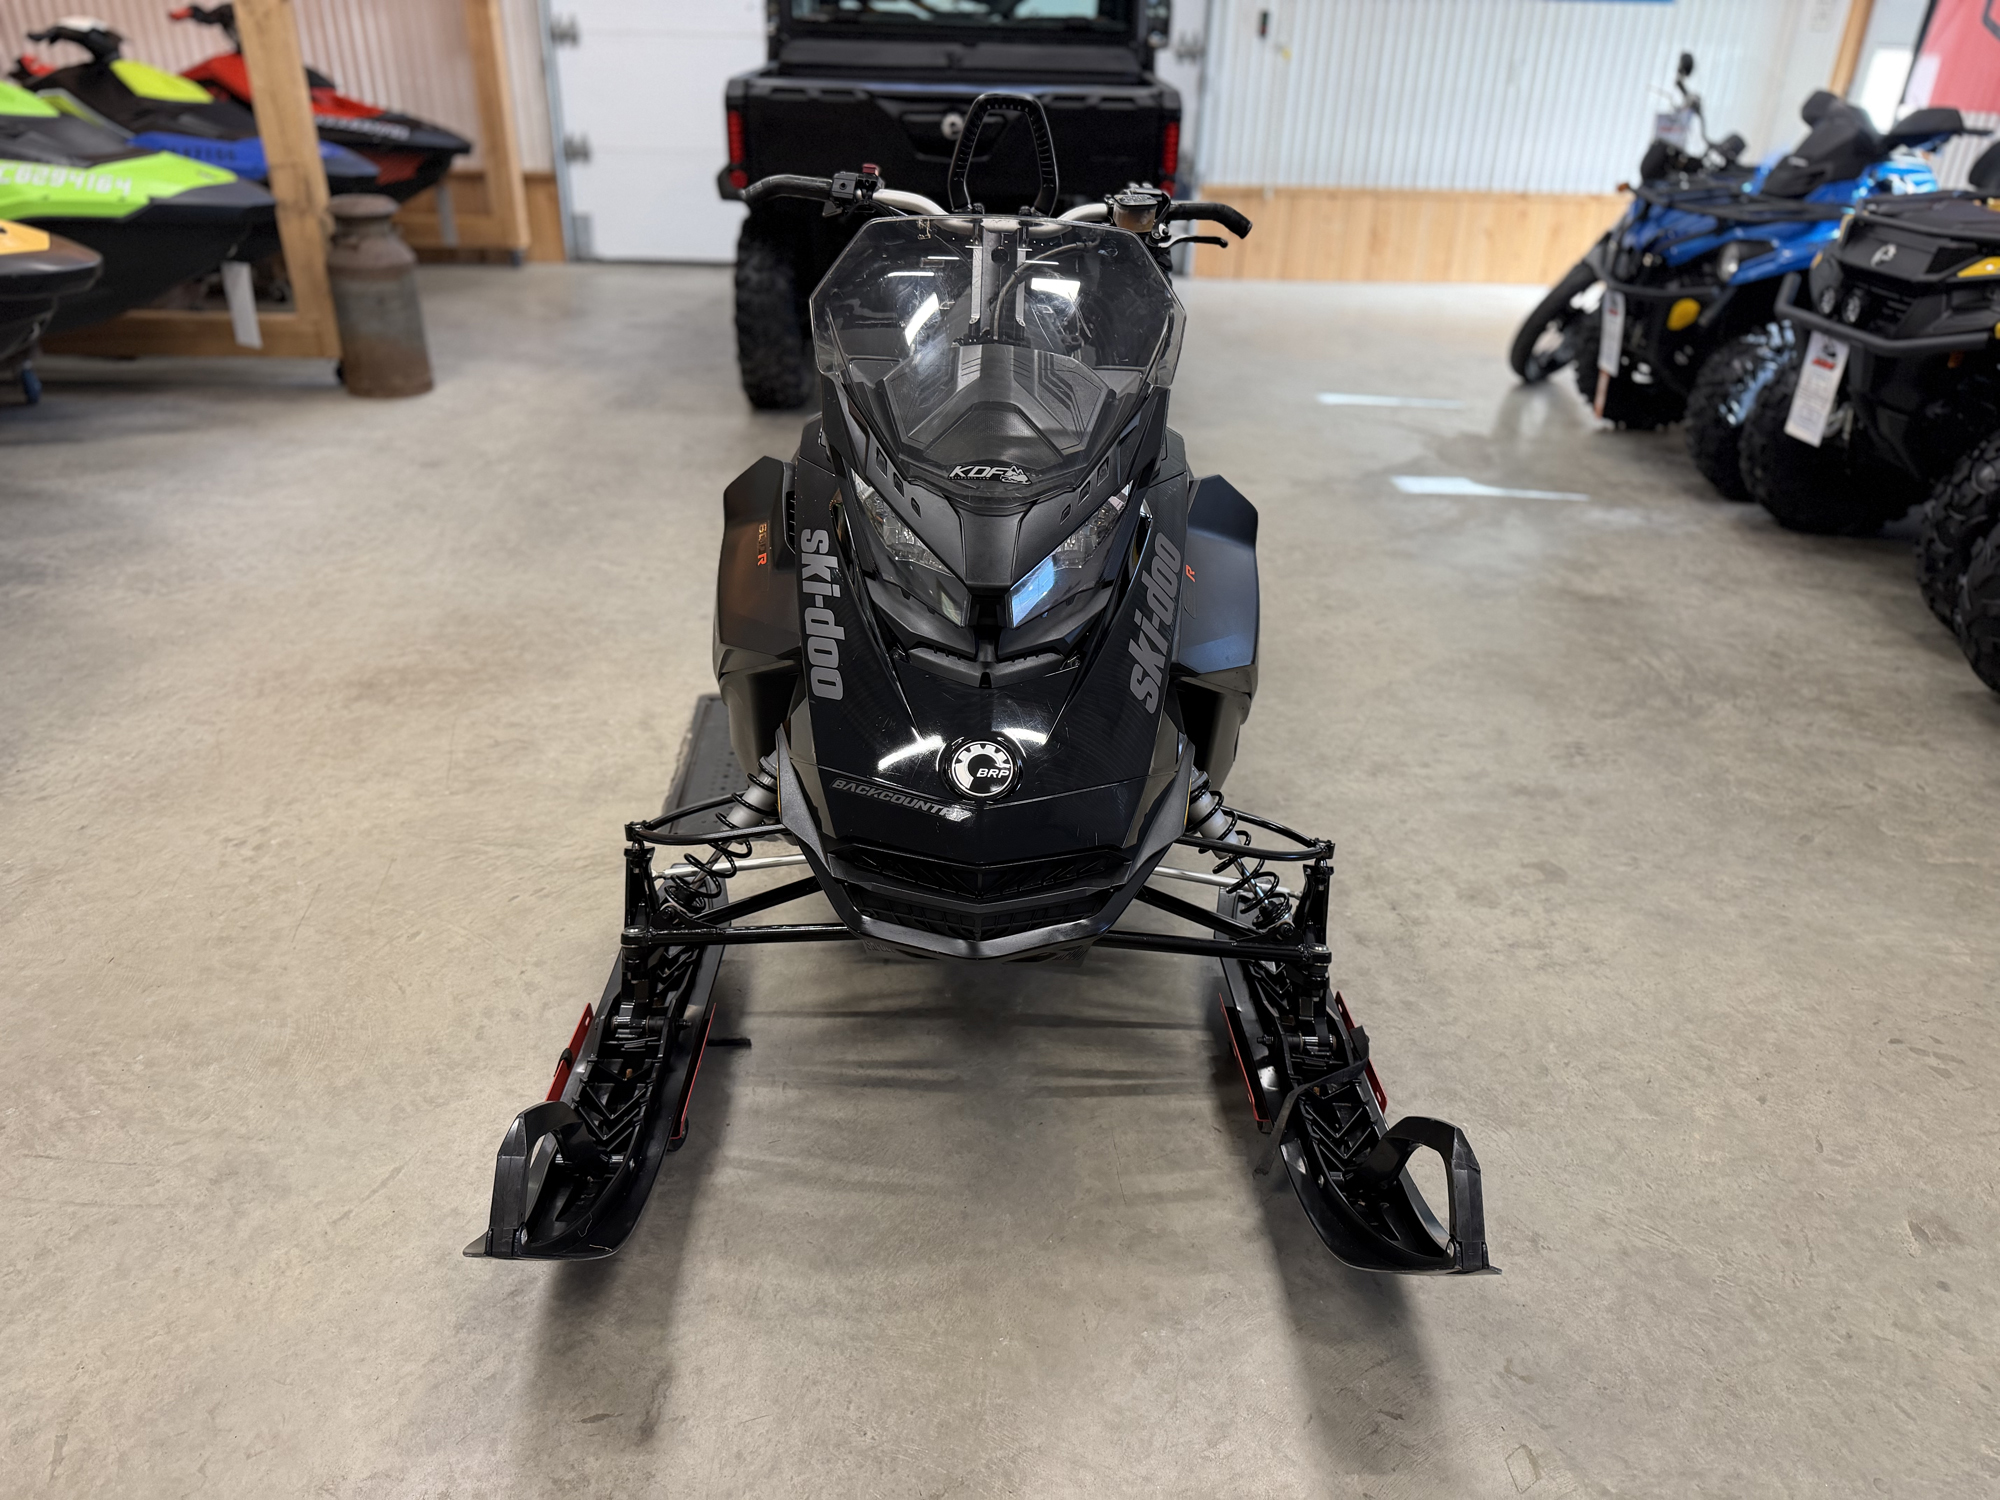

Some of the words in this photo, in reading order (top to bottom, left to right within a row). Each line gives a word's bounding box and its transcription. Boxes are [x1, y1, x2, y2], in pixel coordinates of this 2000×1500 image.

[949, 466, 1010, 477] KDF
[801, 528, 845, 701] ski-doo
[1128, 532, 1181, 714] ski-doo
[976, 768, 1010, 779] BRP
